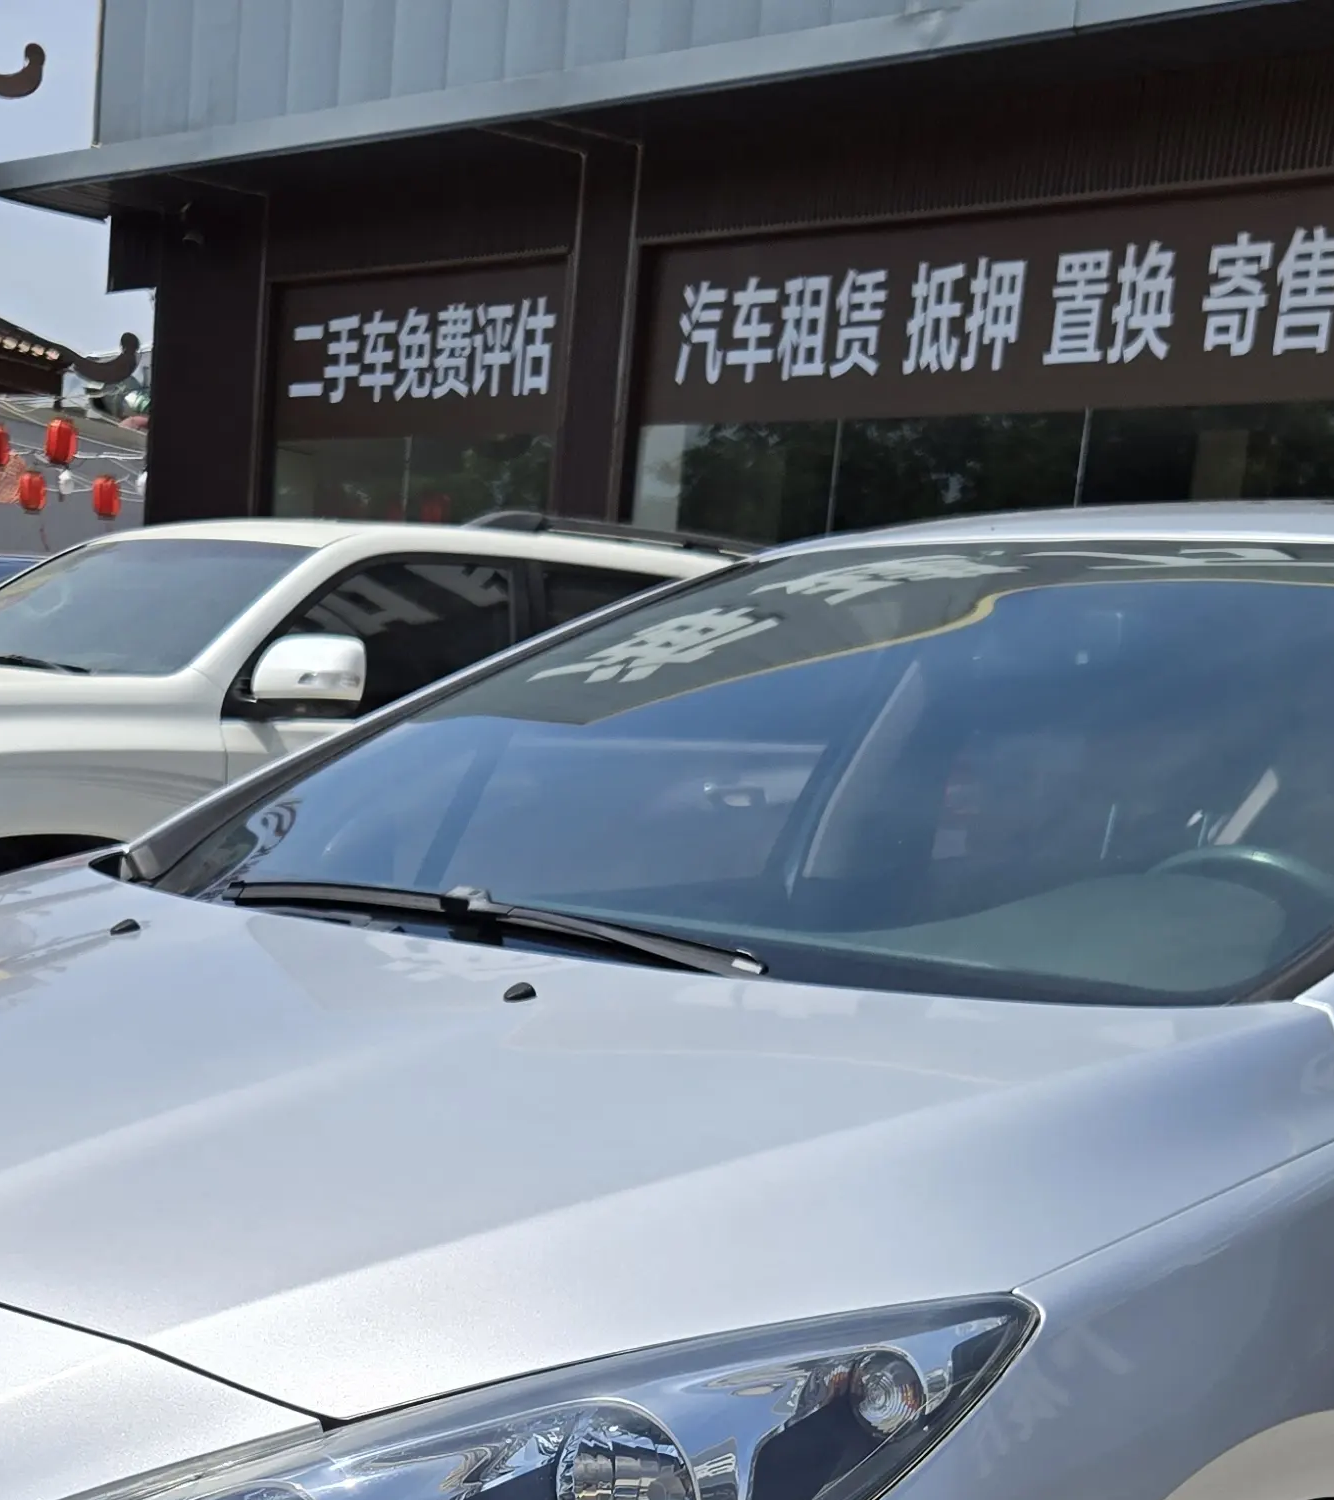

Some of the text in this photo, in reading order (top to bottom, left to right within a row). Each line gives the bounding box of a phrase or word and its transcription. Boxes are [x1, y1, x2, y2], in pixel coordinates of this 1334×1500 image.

[288, 296, 557, 404] 二手车免费评估
[674, 267, 890, 386] 汽车租赁
[901, 256, 1029, 376] 抵押
[1041, 239, 1177, 366] 置换
